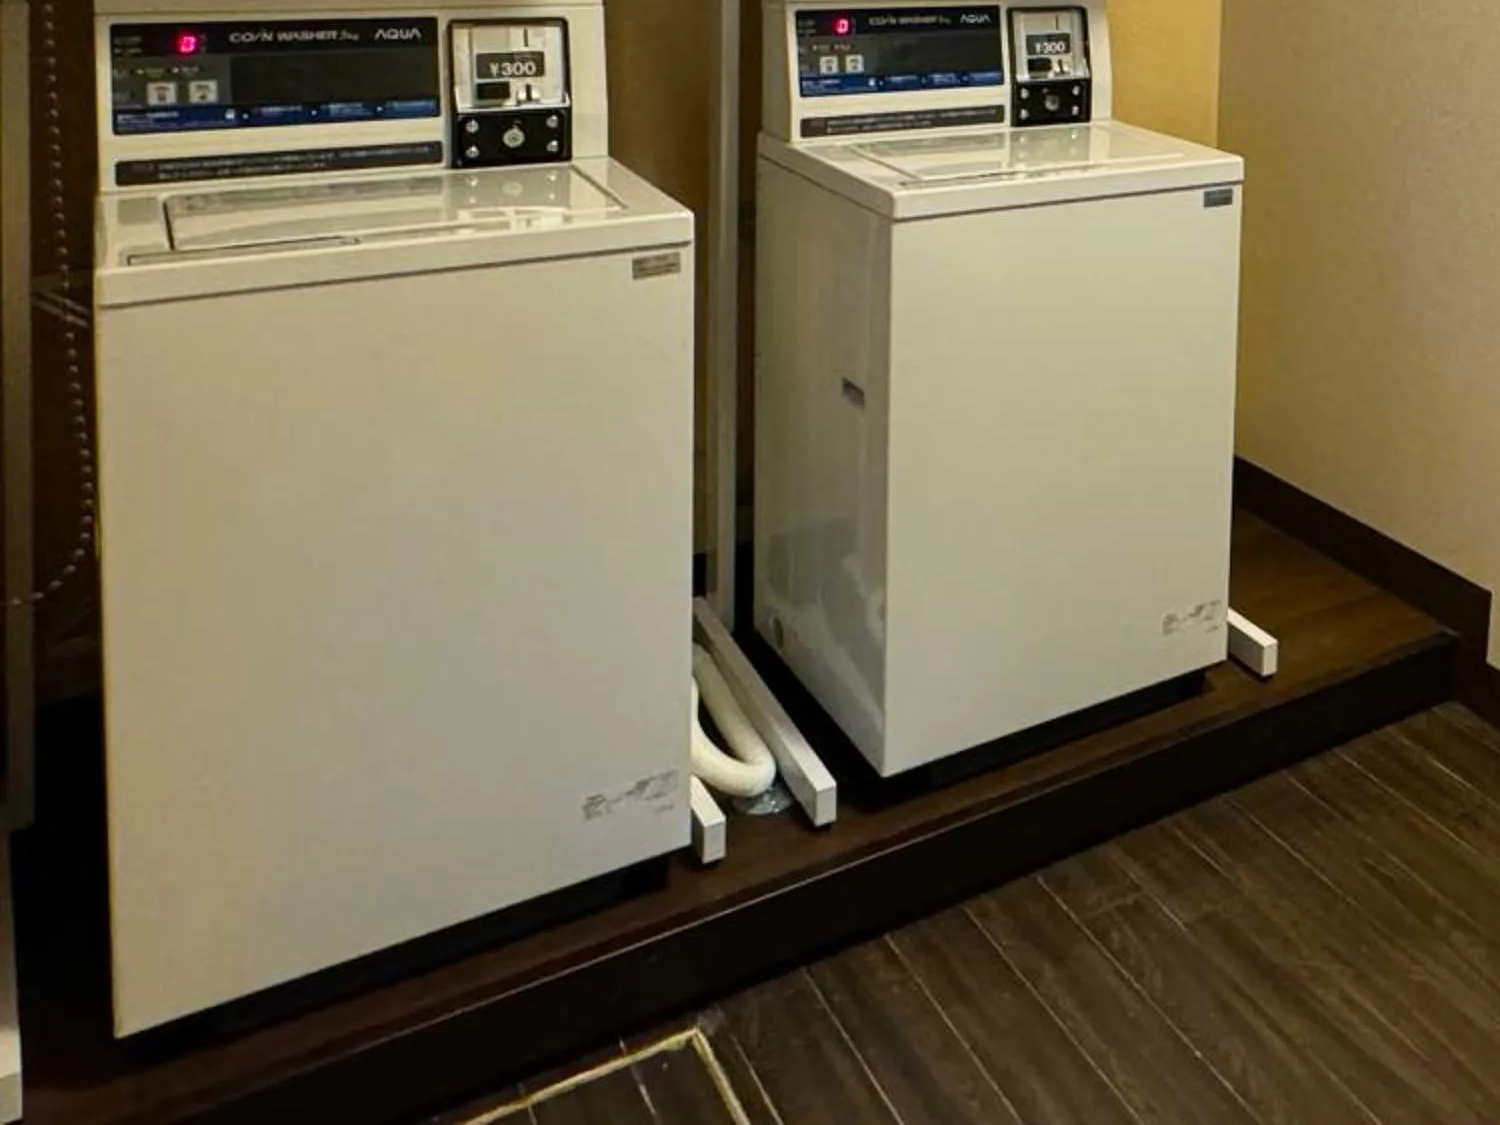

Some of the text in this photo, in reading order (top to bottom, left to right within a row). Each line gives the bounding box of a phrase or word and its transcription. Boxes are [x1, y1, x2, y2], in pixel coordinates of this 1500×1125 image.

[959, 13, 992, 24] AQUA
[374, 26, 422, 40] AQUA
[489, 60, 537, 77] ¥300
